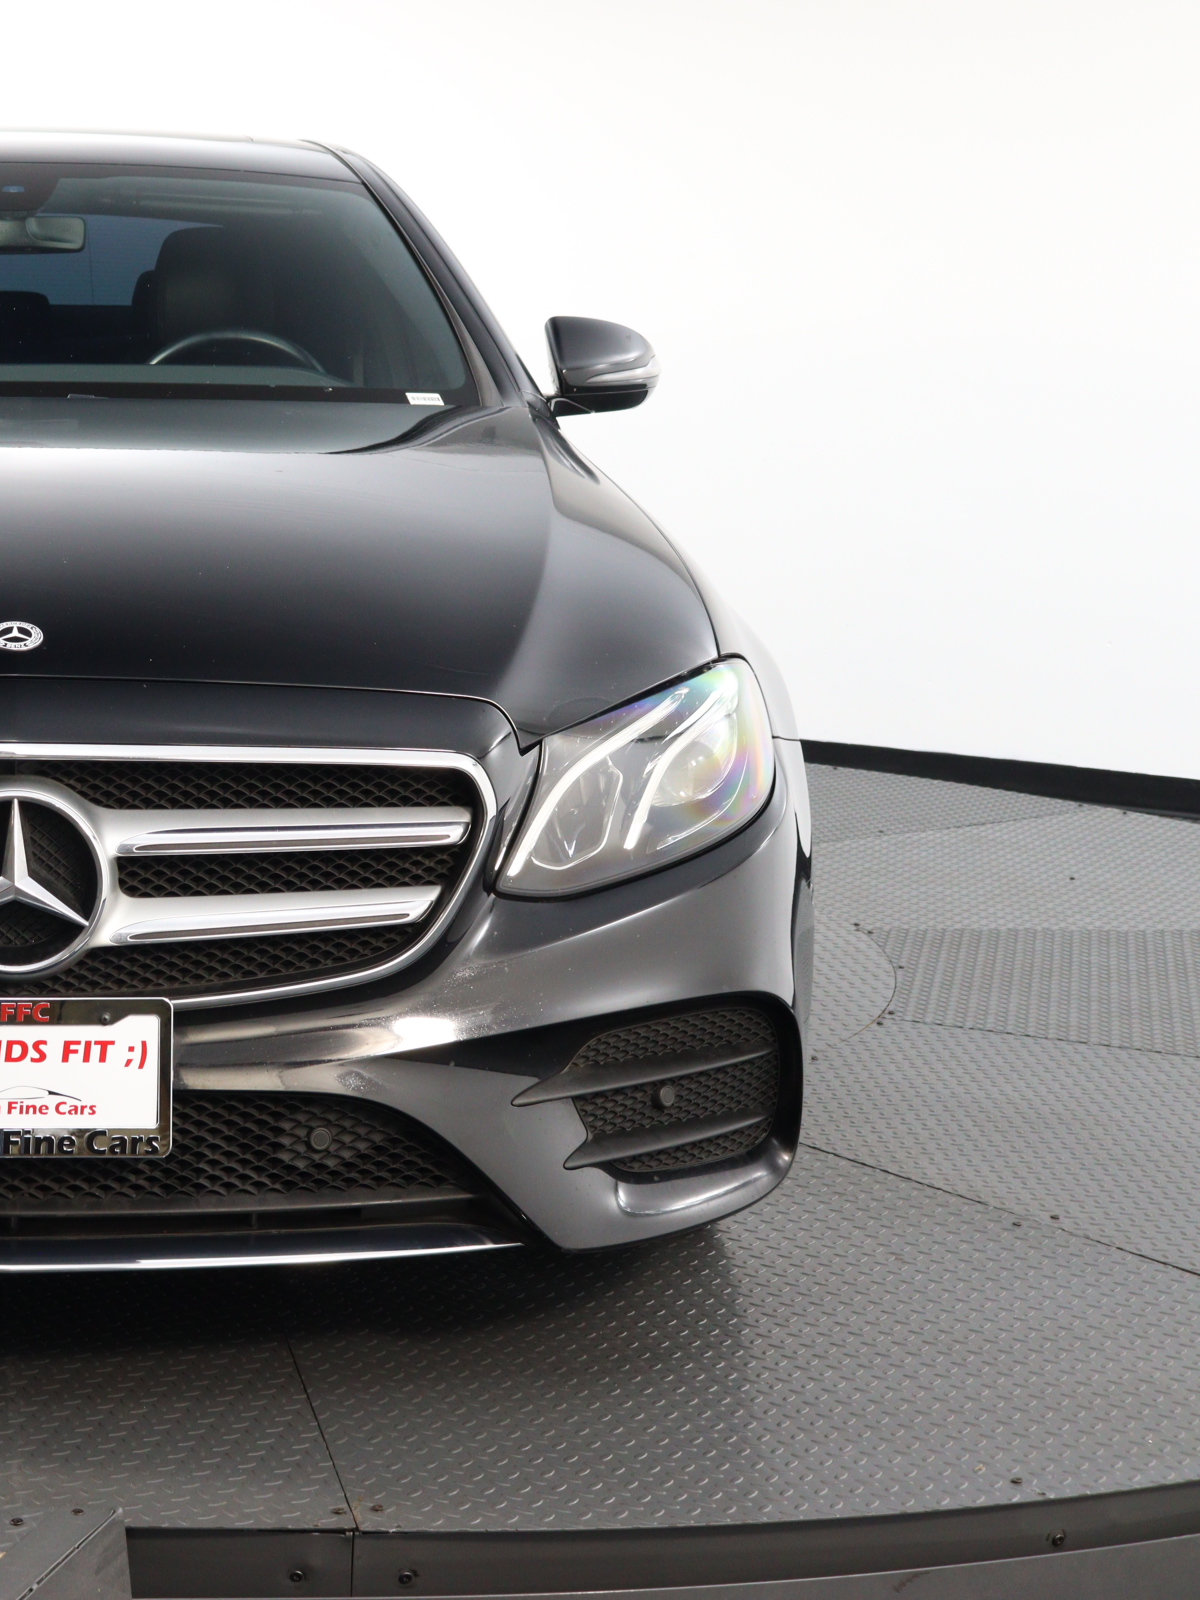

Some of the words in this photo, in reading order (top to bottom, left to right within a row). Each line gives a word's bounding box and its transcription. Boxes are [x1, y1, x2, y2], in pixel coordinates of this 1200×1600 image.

[61, 1040, 115, 1063] FIT
[124, 1040, 148, 1069] ;)
[7, 1101, 49, 1115] Fine
[54, 1101, 97, 1116] Cars
[2, 1129, 77, 1156] Fine
[85, 1129, 161, 1156] Cars
